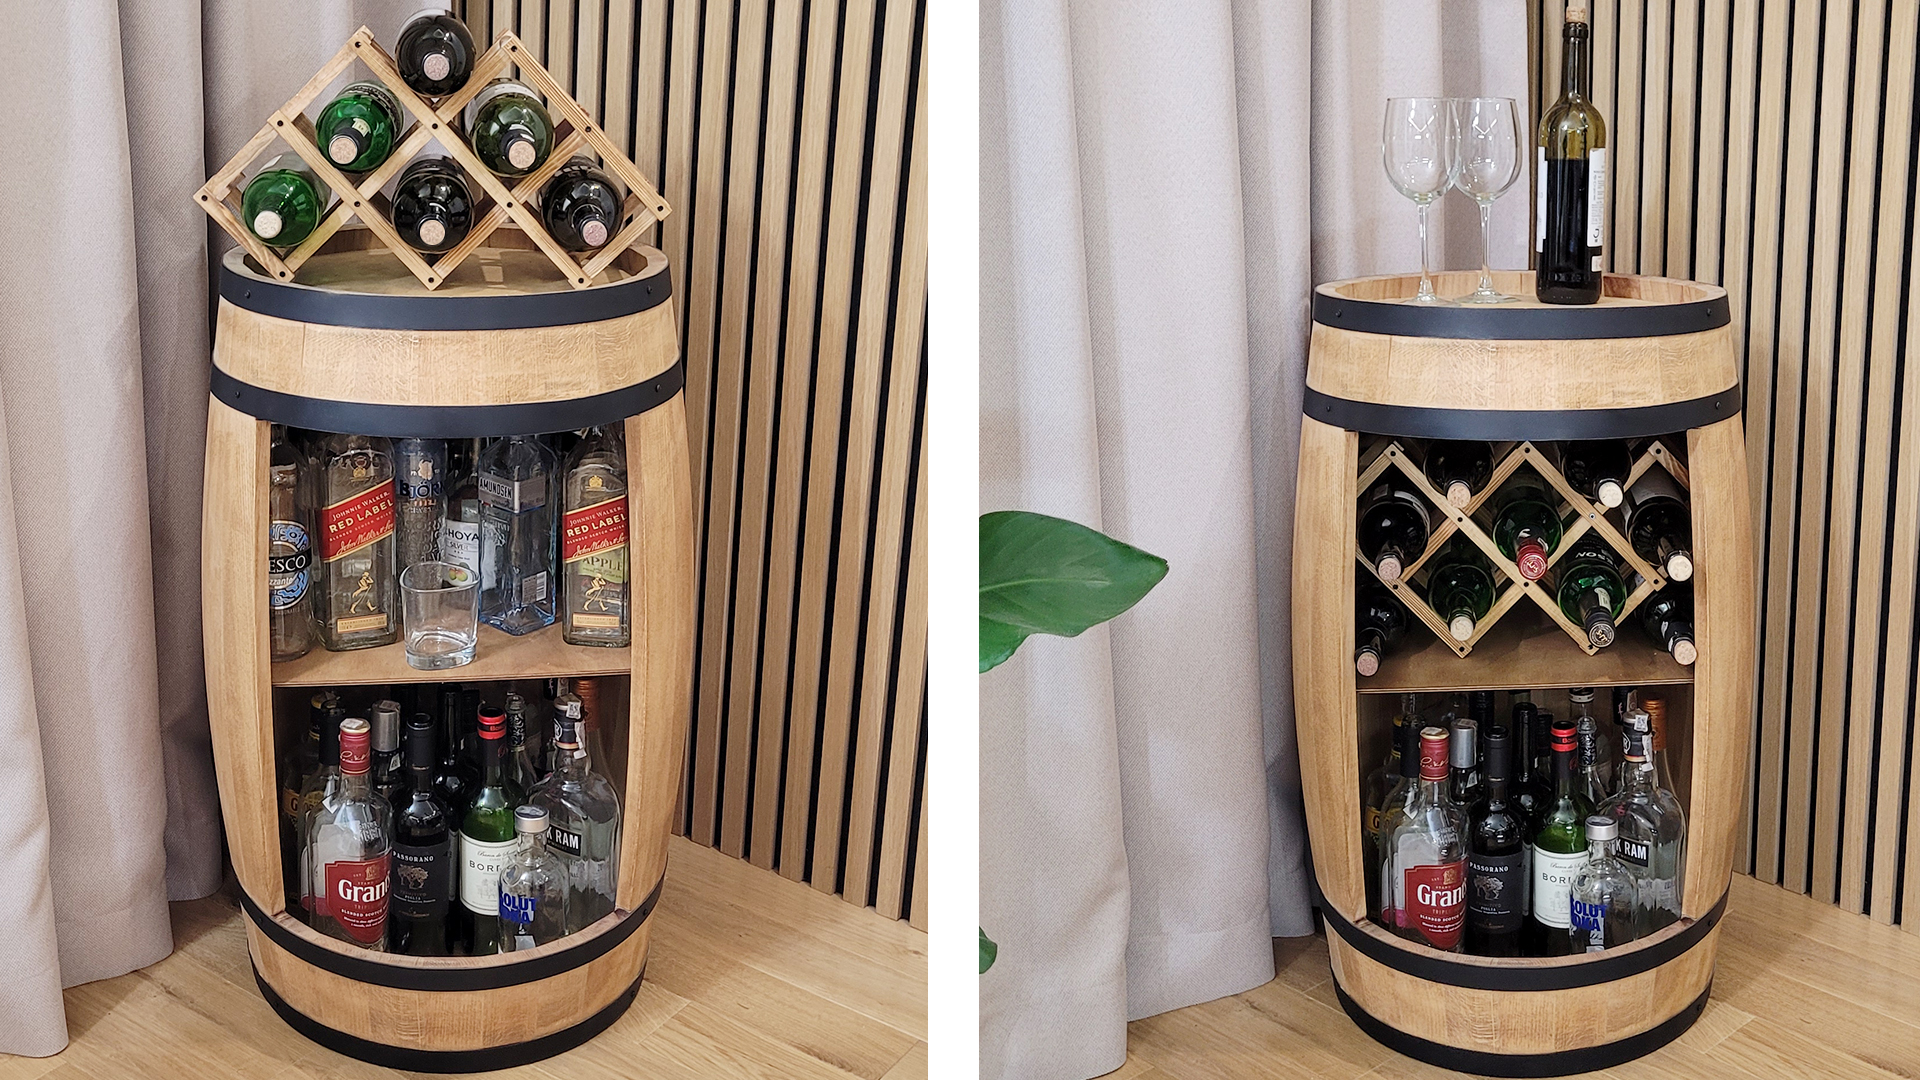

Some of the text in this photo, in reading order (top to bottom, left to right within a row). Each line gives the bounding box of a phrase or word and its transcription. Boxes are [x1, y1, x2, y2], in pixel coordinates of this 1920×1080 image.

[479, 476, 512, 499] AMUNDSEN
[328, 516, 354, 534] RED
[356, 499, 394, 522] LABEL
[332, 504, 361, 522] JOHNNIE
[569, 514, 596, 527] JOHNNIE
[566, 513, 626, 538] RED LABEL
[555, 829, 579, 849] RAM
[393, 850, 434, 862] PASSORANO
[1624, 841, 1647, 860] RAM
[1469, 861, 1509, 873] PASSORANO
